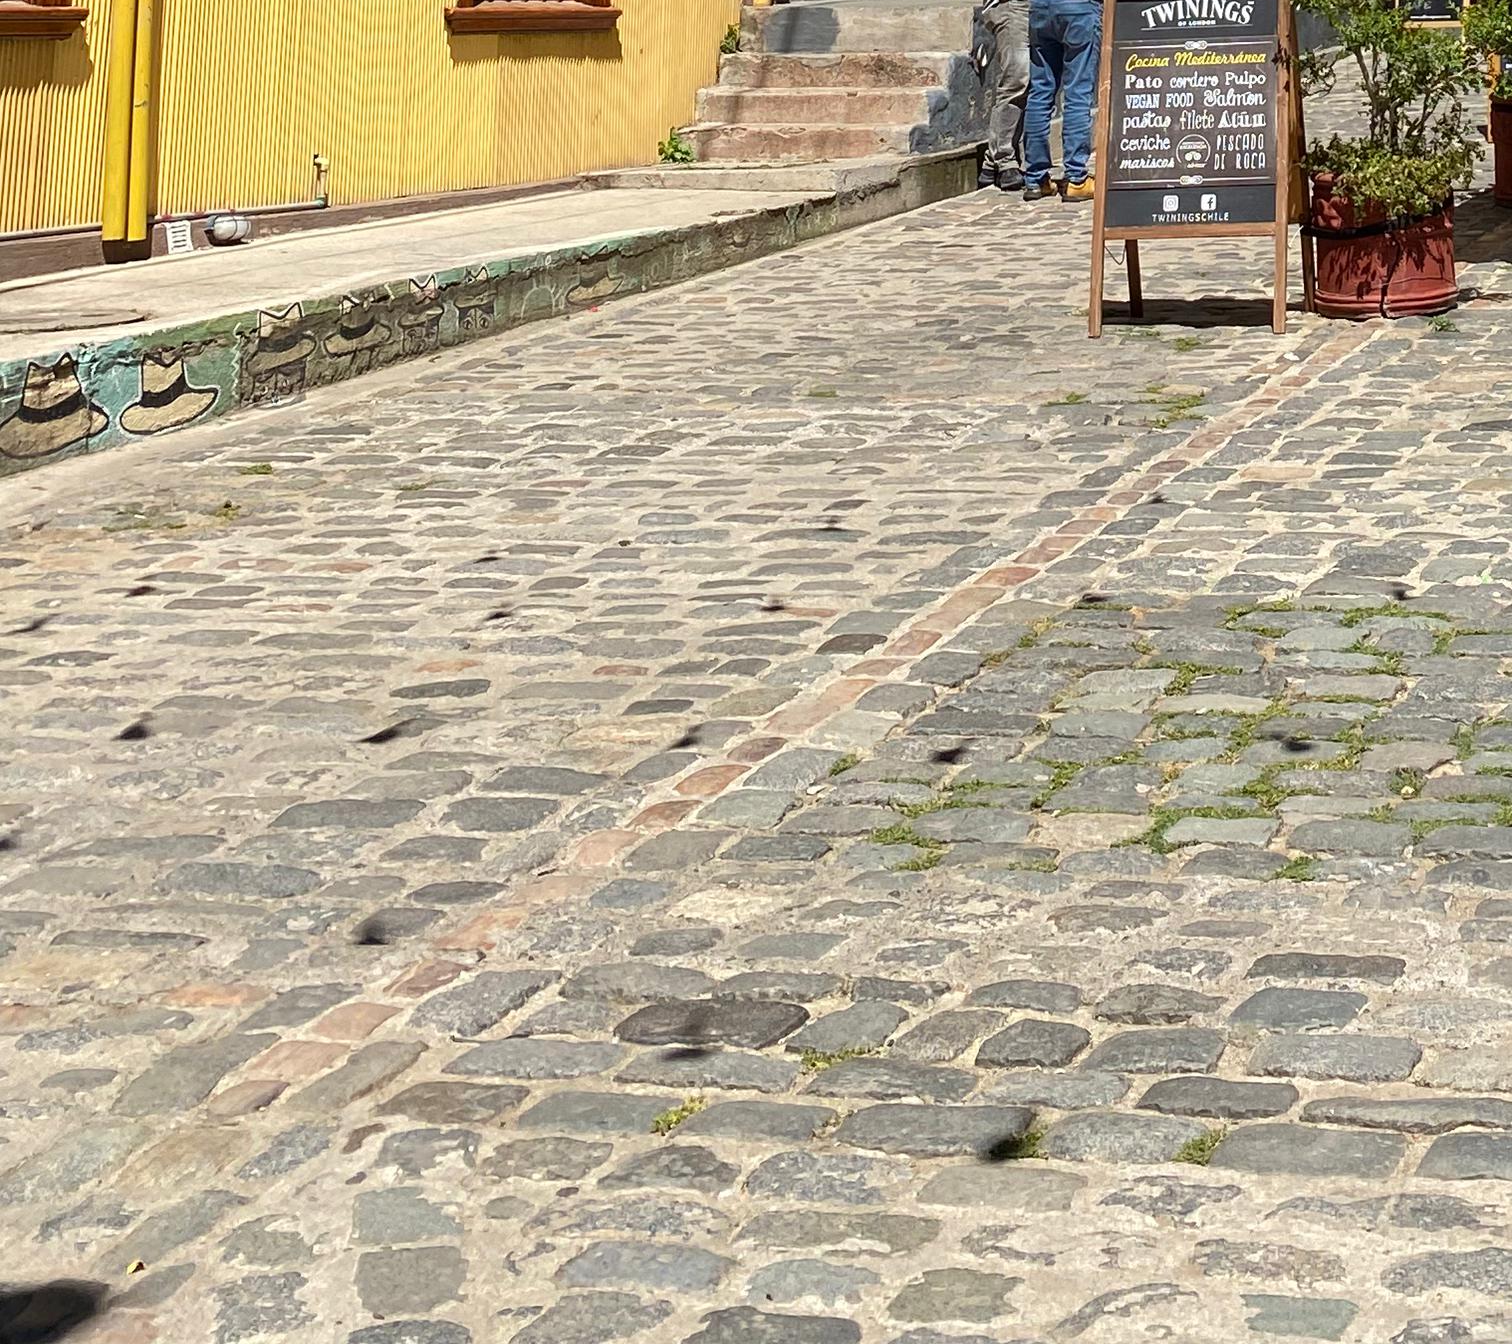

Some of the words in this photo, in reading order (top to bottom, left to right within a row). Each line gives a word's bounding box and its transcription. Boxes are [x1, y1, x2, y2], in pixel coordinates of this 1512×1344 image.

[1125, 53, 1170, 72] Cocina
[1174, 51, 1267, 67] Mediterránea
[1124, 74, 1163, 89] Pato
[1169, 71, 1219, 88] cordero
[1224, 71, 1267, 89] Pulpo
[1125, 93, 1161, 109] VEGAN
[1165, 92, 1194, 108] FOOD
[1122, 111, 1172, 135] pastas
[1120, 133, 1171, 152] ceviche
[1216, 133, 1265, 152] PESCADO
[1119, 154, 1175, 169] mariscos
[1213, 152, 1226, 171] DE
[1235, 152, 1266, 170] ROCA
[1151, 211, 1230, 223] TWININGSCHILE
